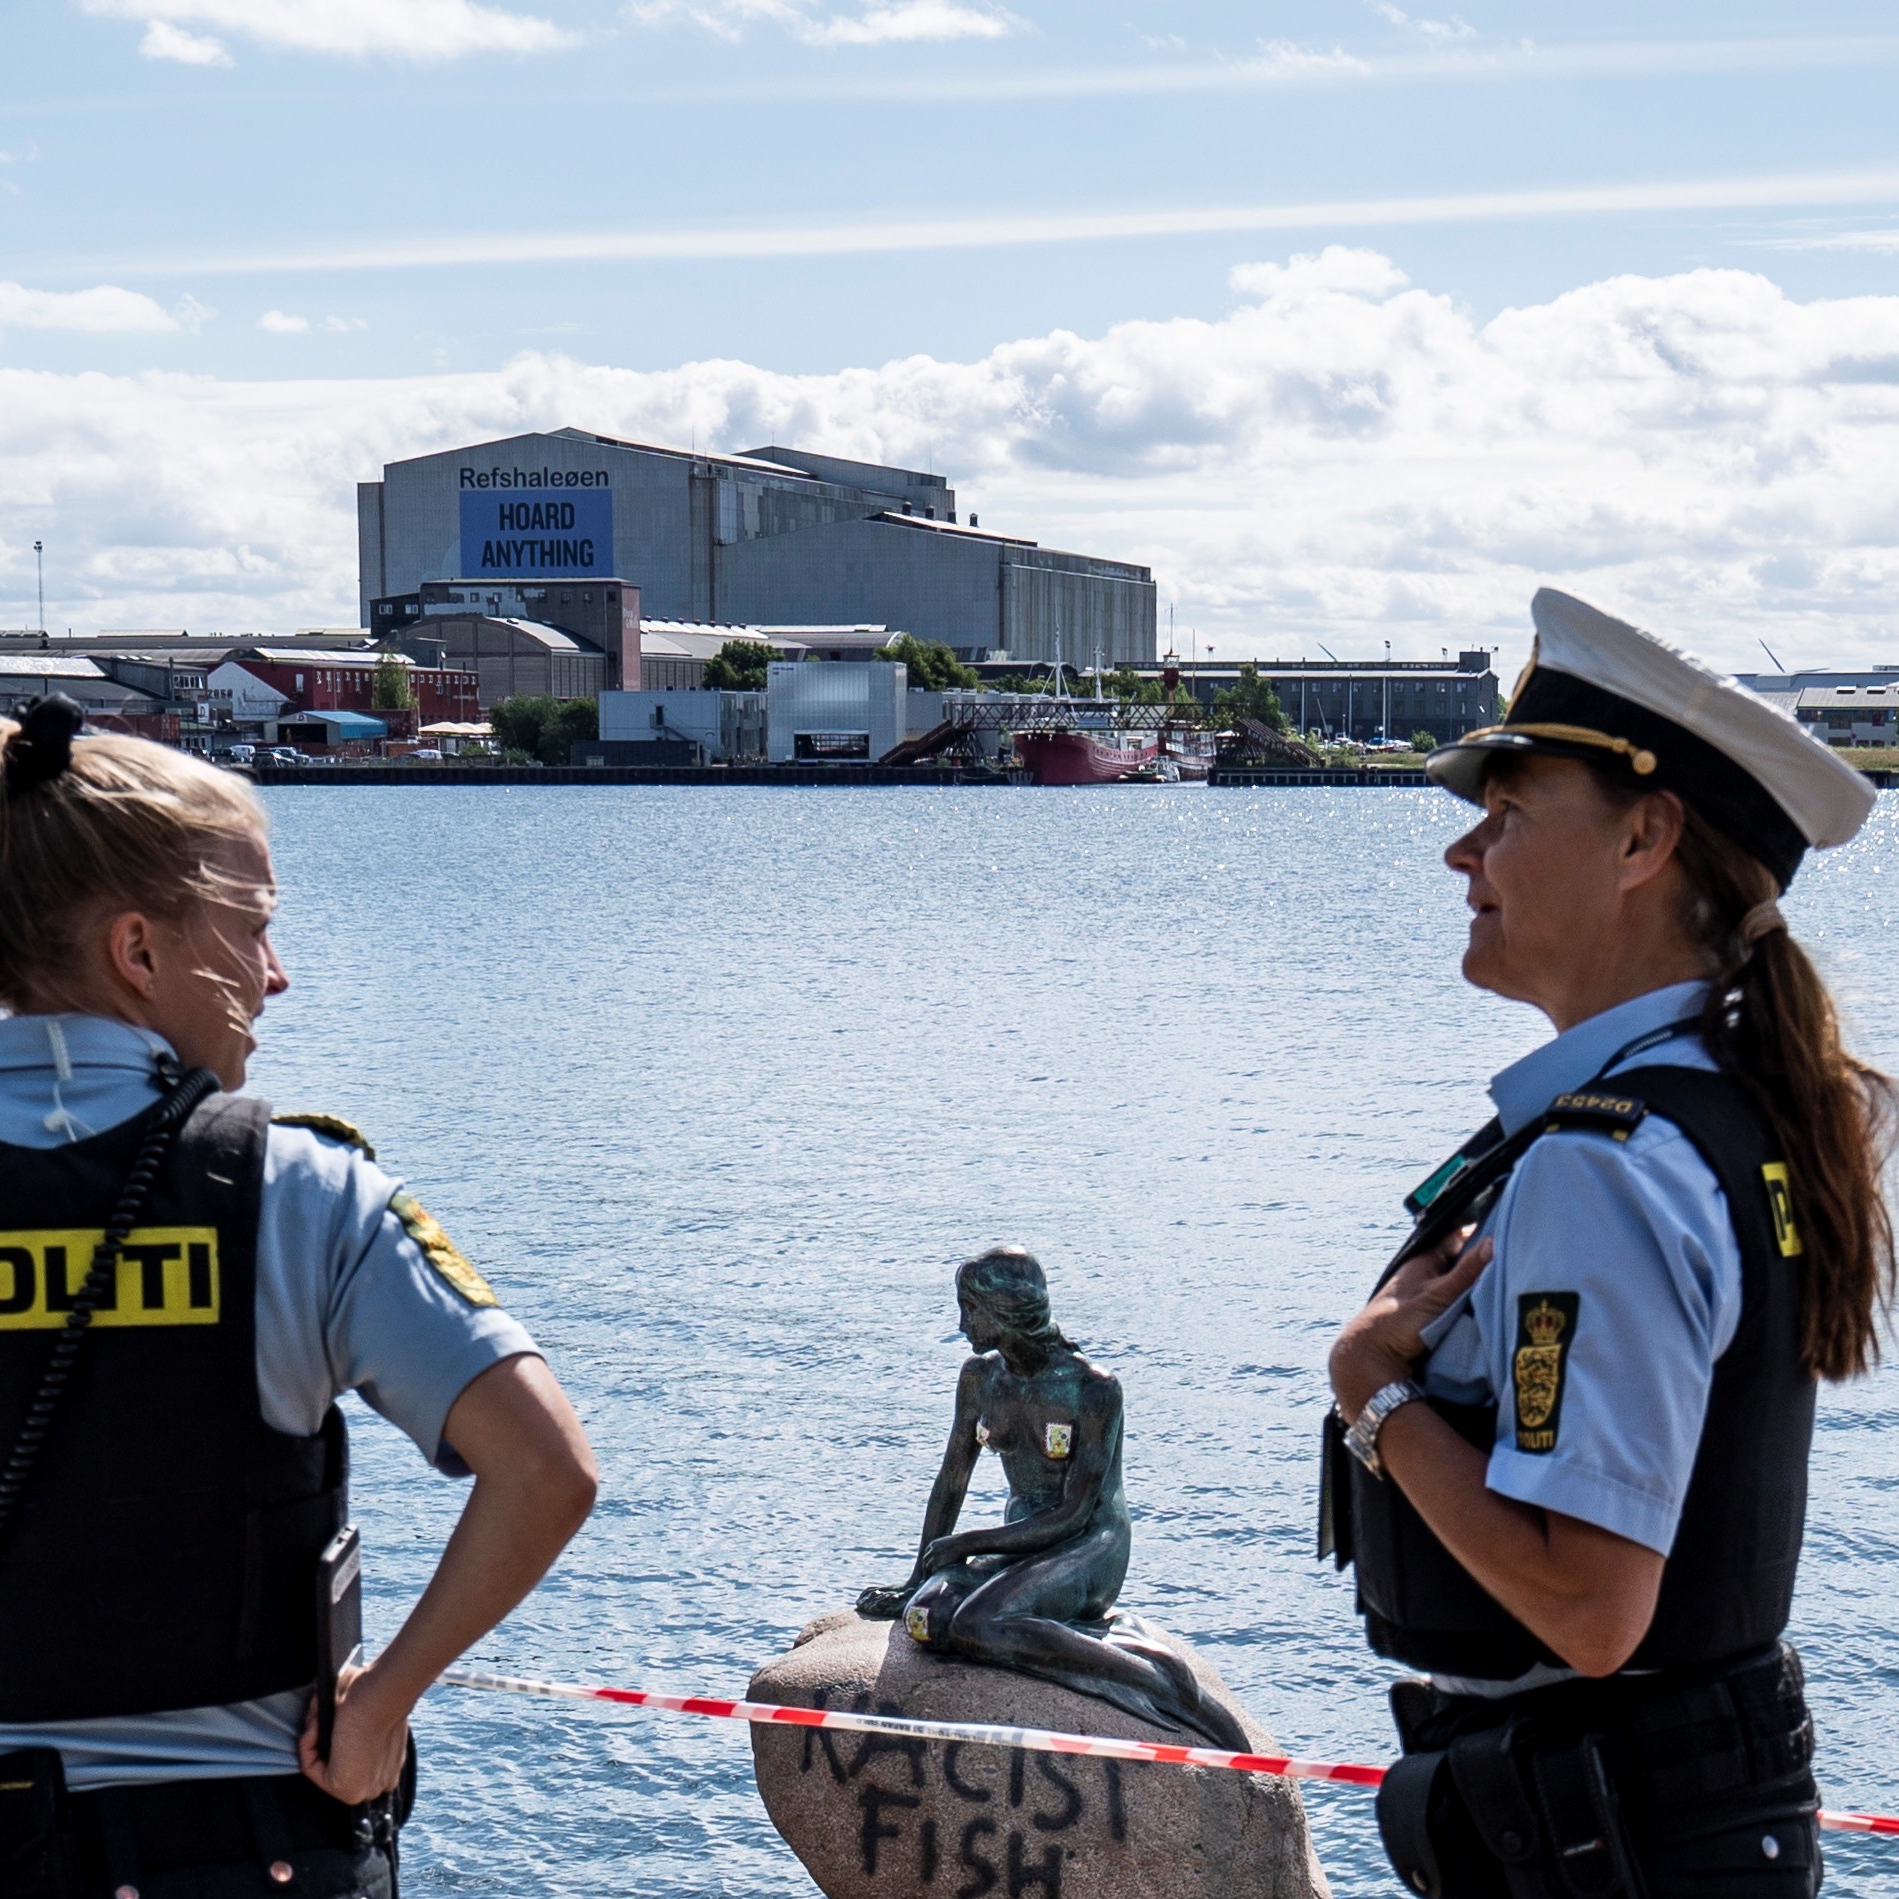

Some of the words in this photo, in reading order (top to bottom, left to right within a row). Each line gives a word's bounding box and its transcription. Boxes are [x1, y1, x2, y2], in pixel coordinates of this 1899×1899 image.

[459, 466, 609, 489] Refshaleøen
[498, 502, 576, 531] HOARD
[480, 538, 594, 568] ANYTHING
